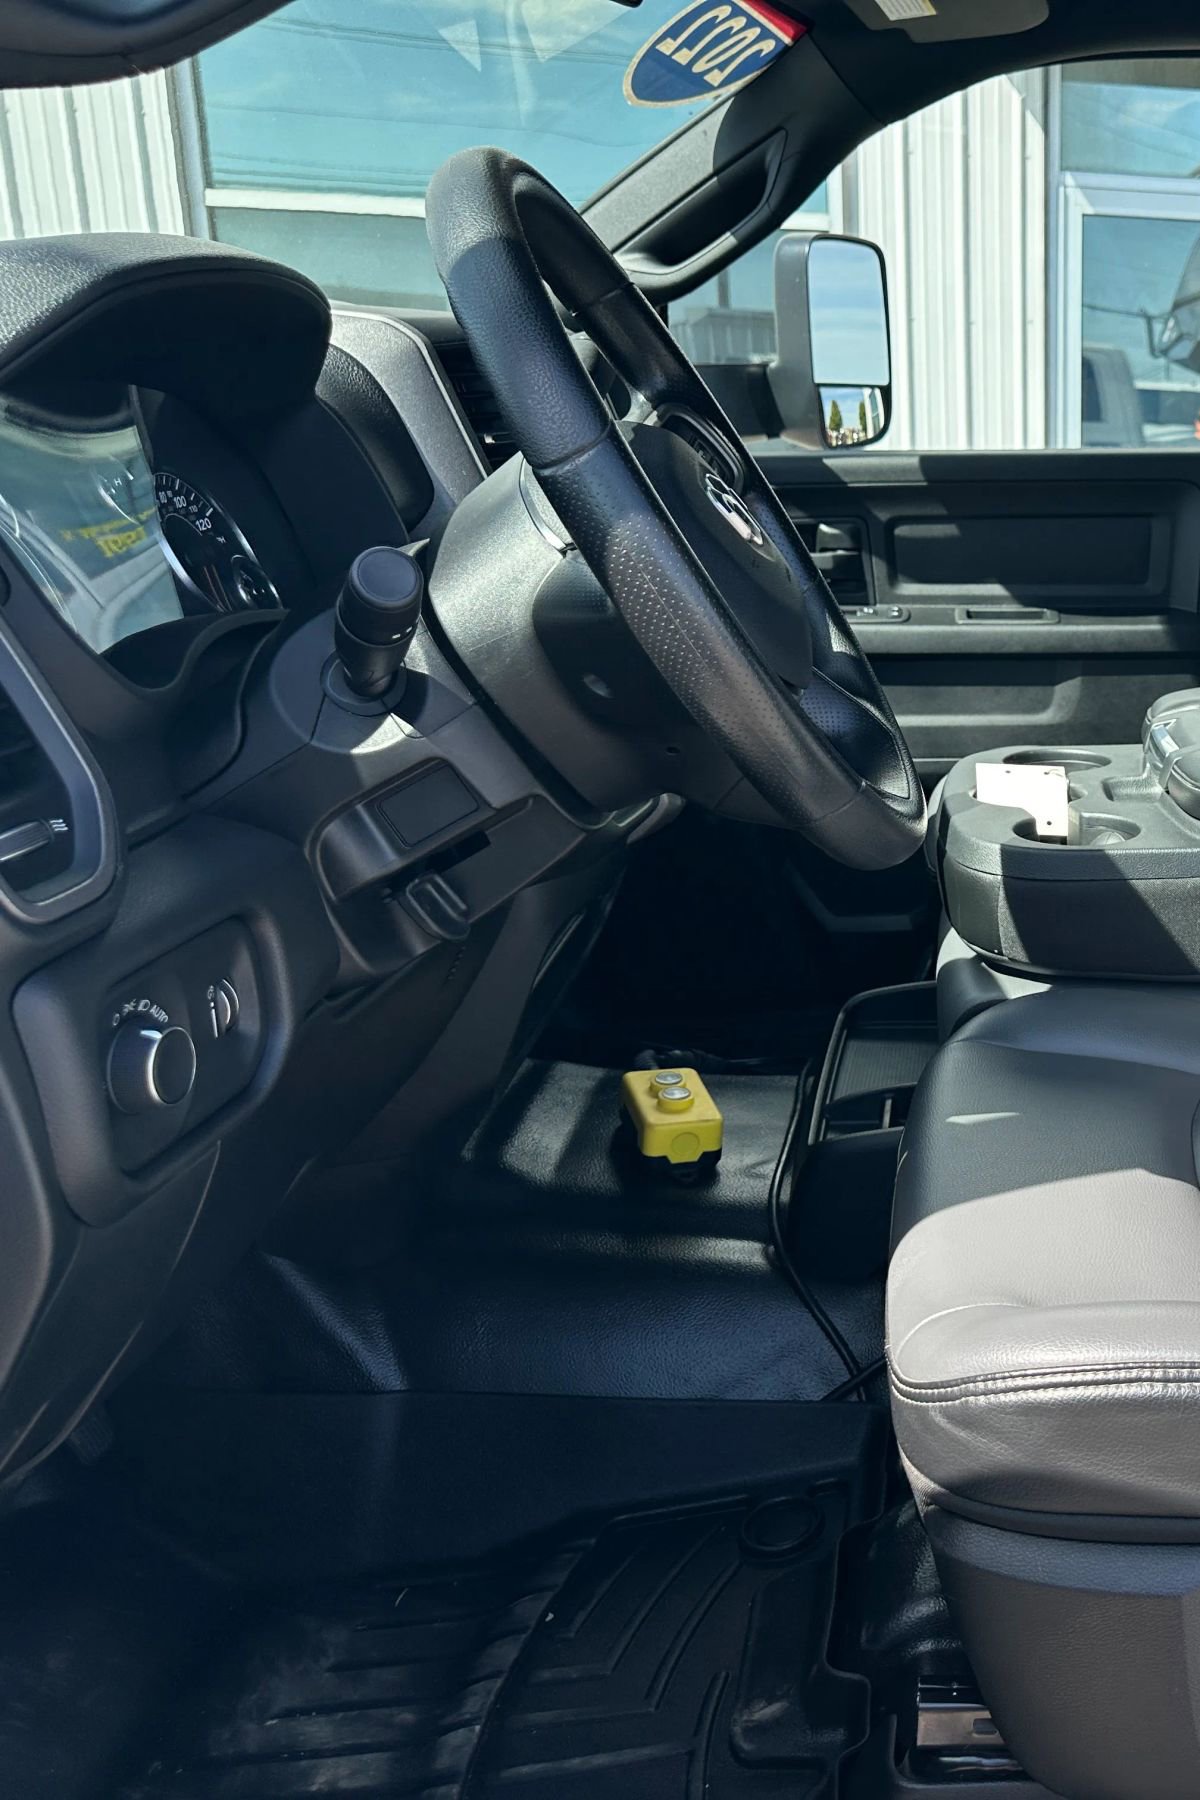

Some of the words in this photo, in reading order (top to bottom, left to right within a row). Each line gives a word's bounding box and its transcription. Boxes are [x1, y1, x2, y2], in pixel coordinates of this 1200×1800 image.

[173, 495, 187, 509] 100
[195, 517, 212, 531] 120
[149, 1005, 169, 1023] AUTO
